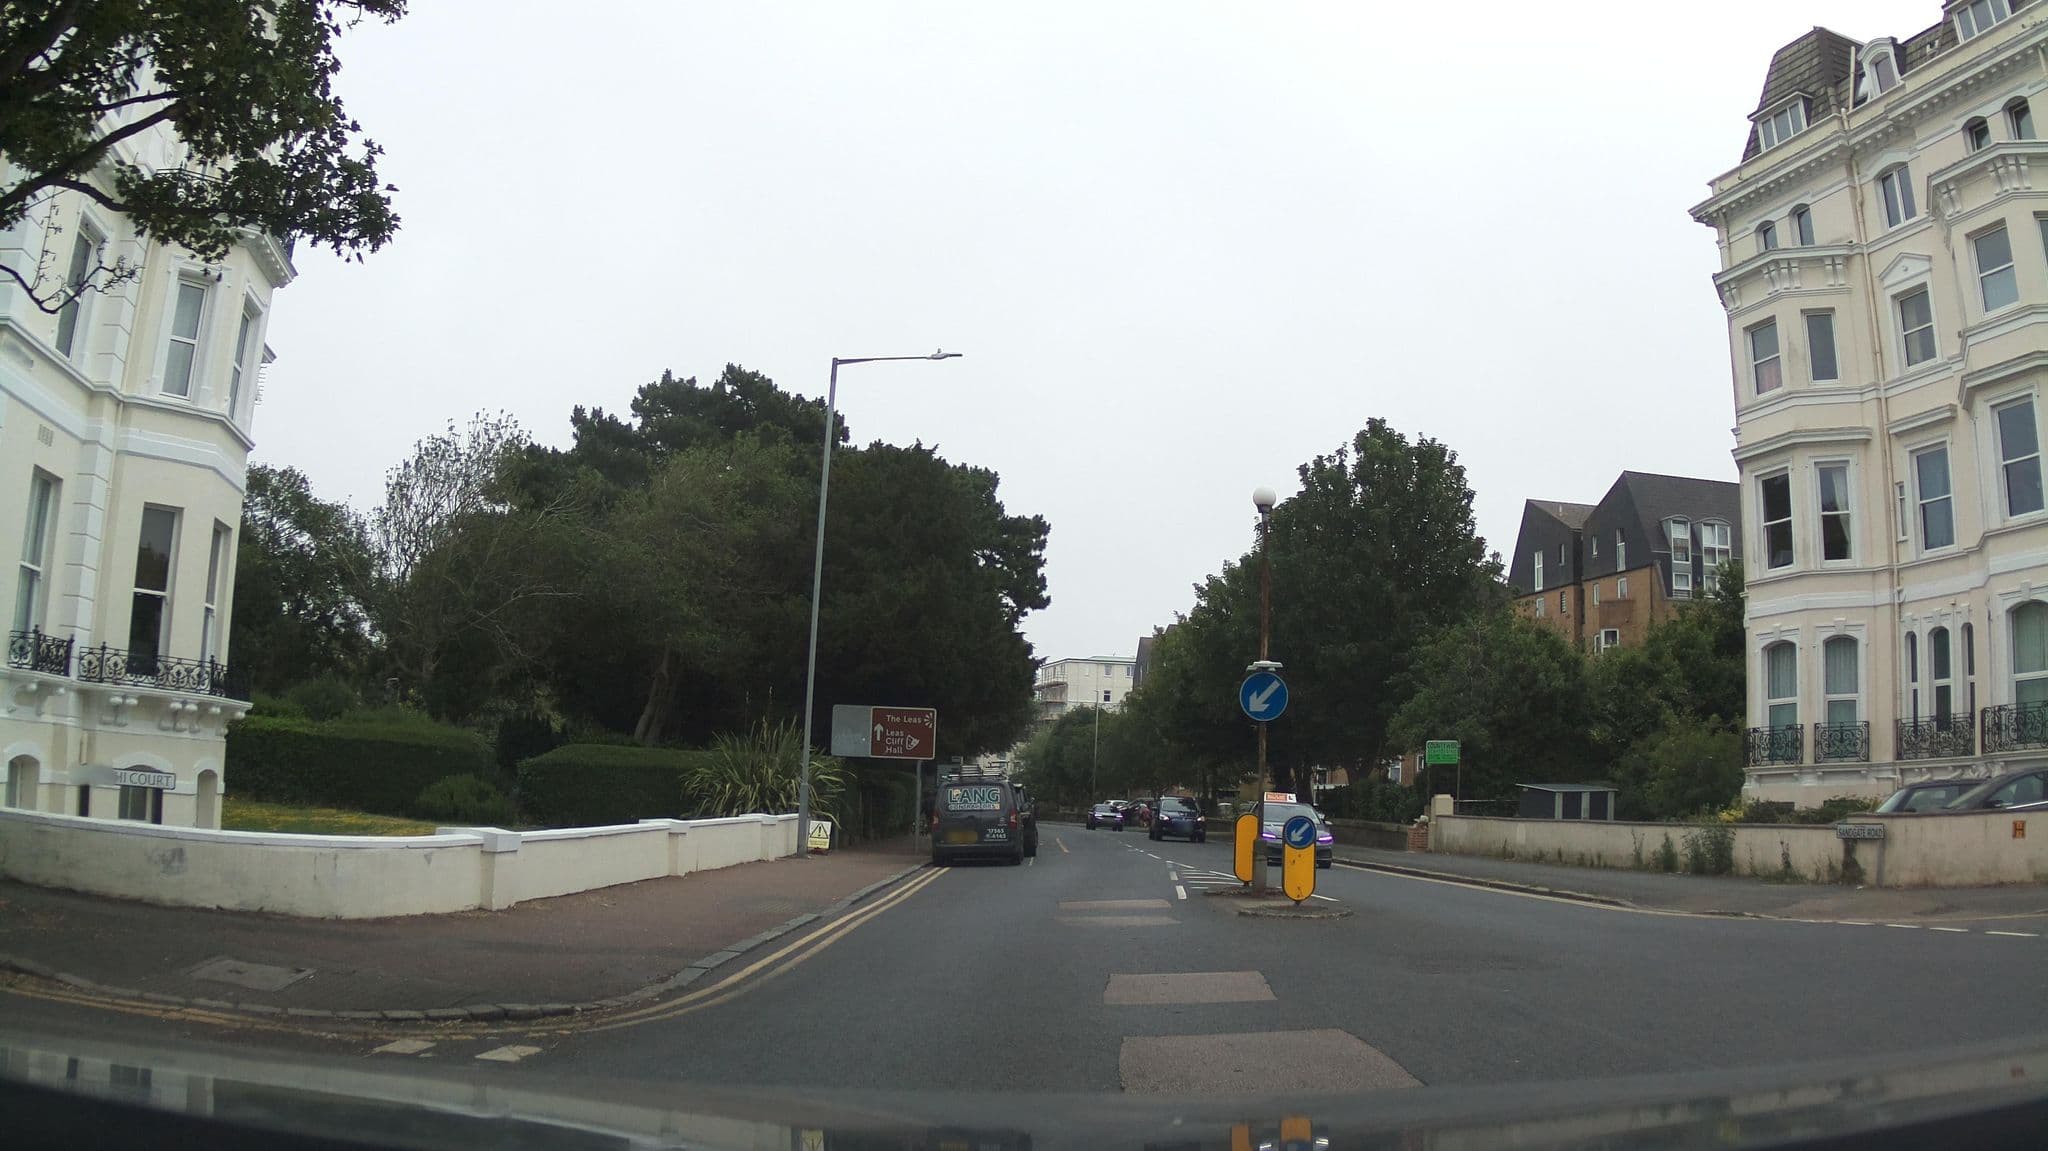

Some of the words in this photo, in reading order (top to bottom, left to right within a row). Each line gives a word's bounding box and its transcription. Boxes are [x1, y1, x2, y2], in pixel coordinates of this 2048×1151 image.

[886, 714, 901, 723] The
[903, 715, 922, 724] Leas
[886, 729, 904, 737] Leas
[885, 737, 904, 745] Cliff
[885, 746, 903, 754] Hall
[129, 772, 172, 787] COURT
[948, 787, 1001, 804] LANG
